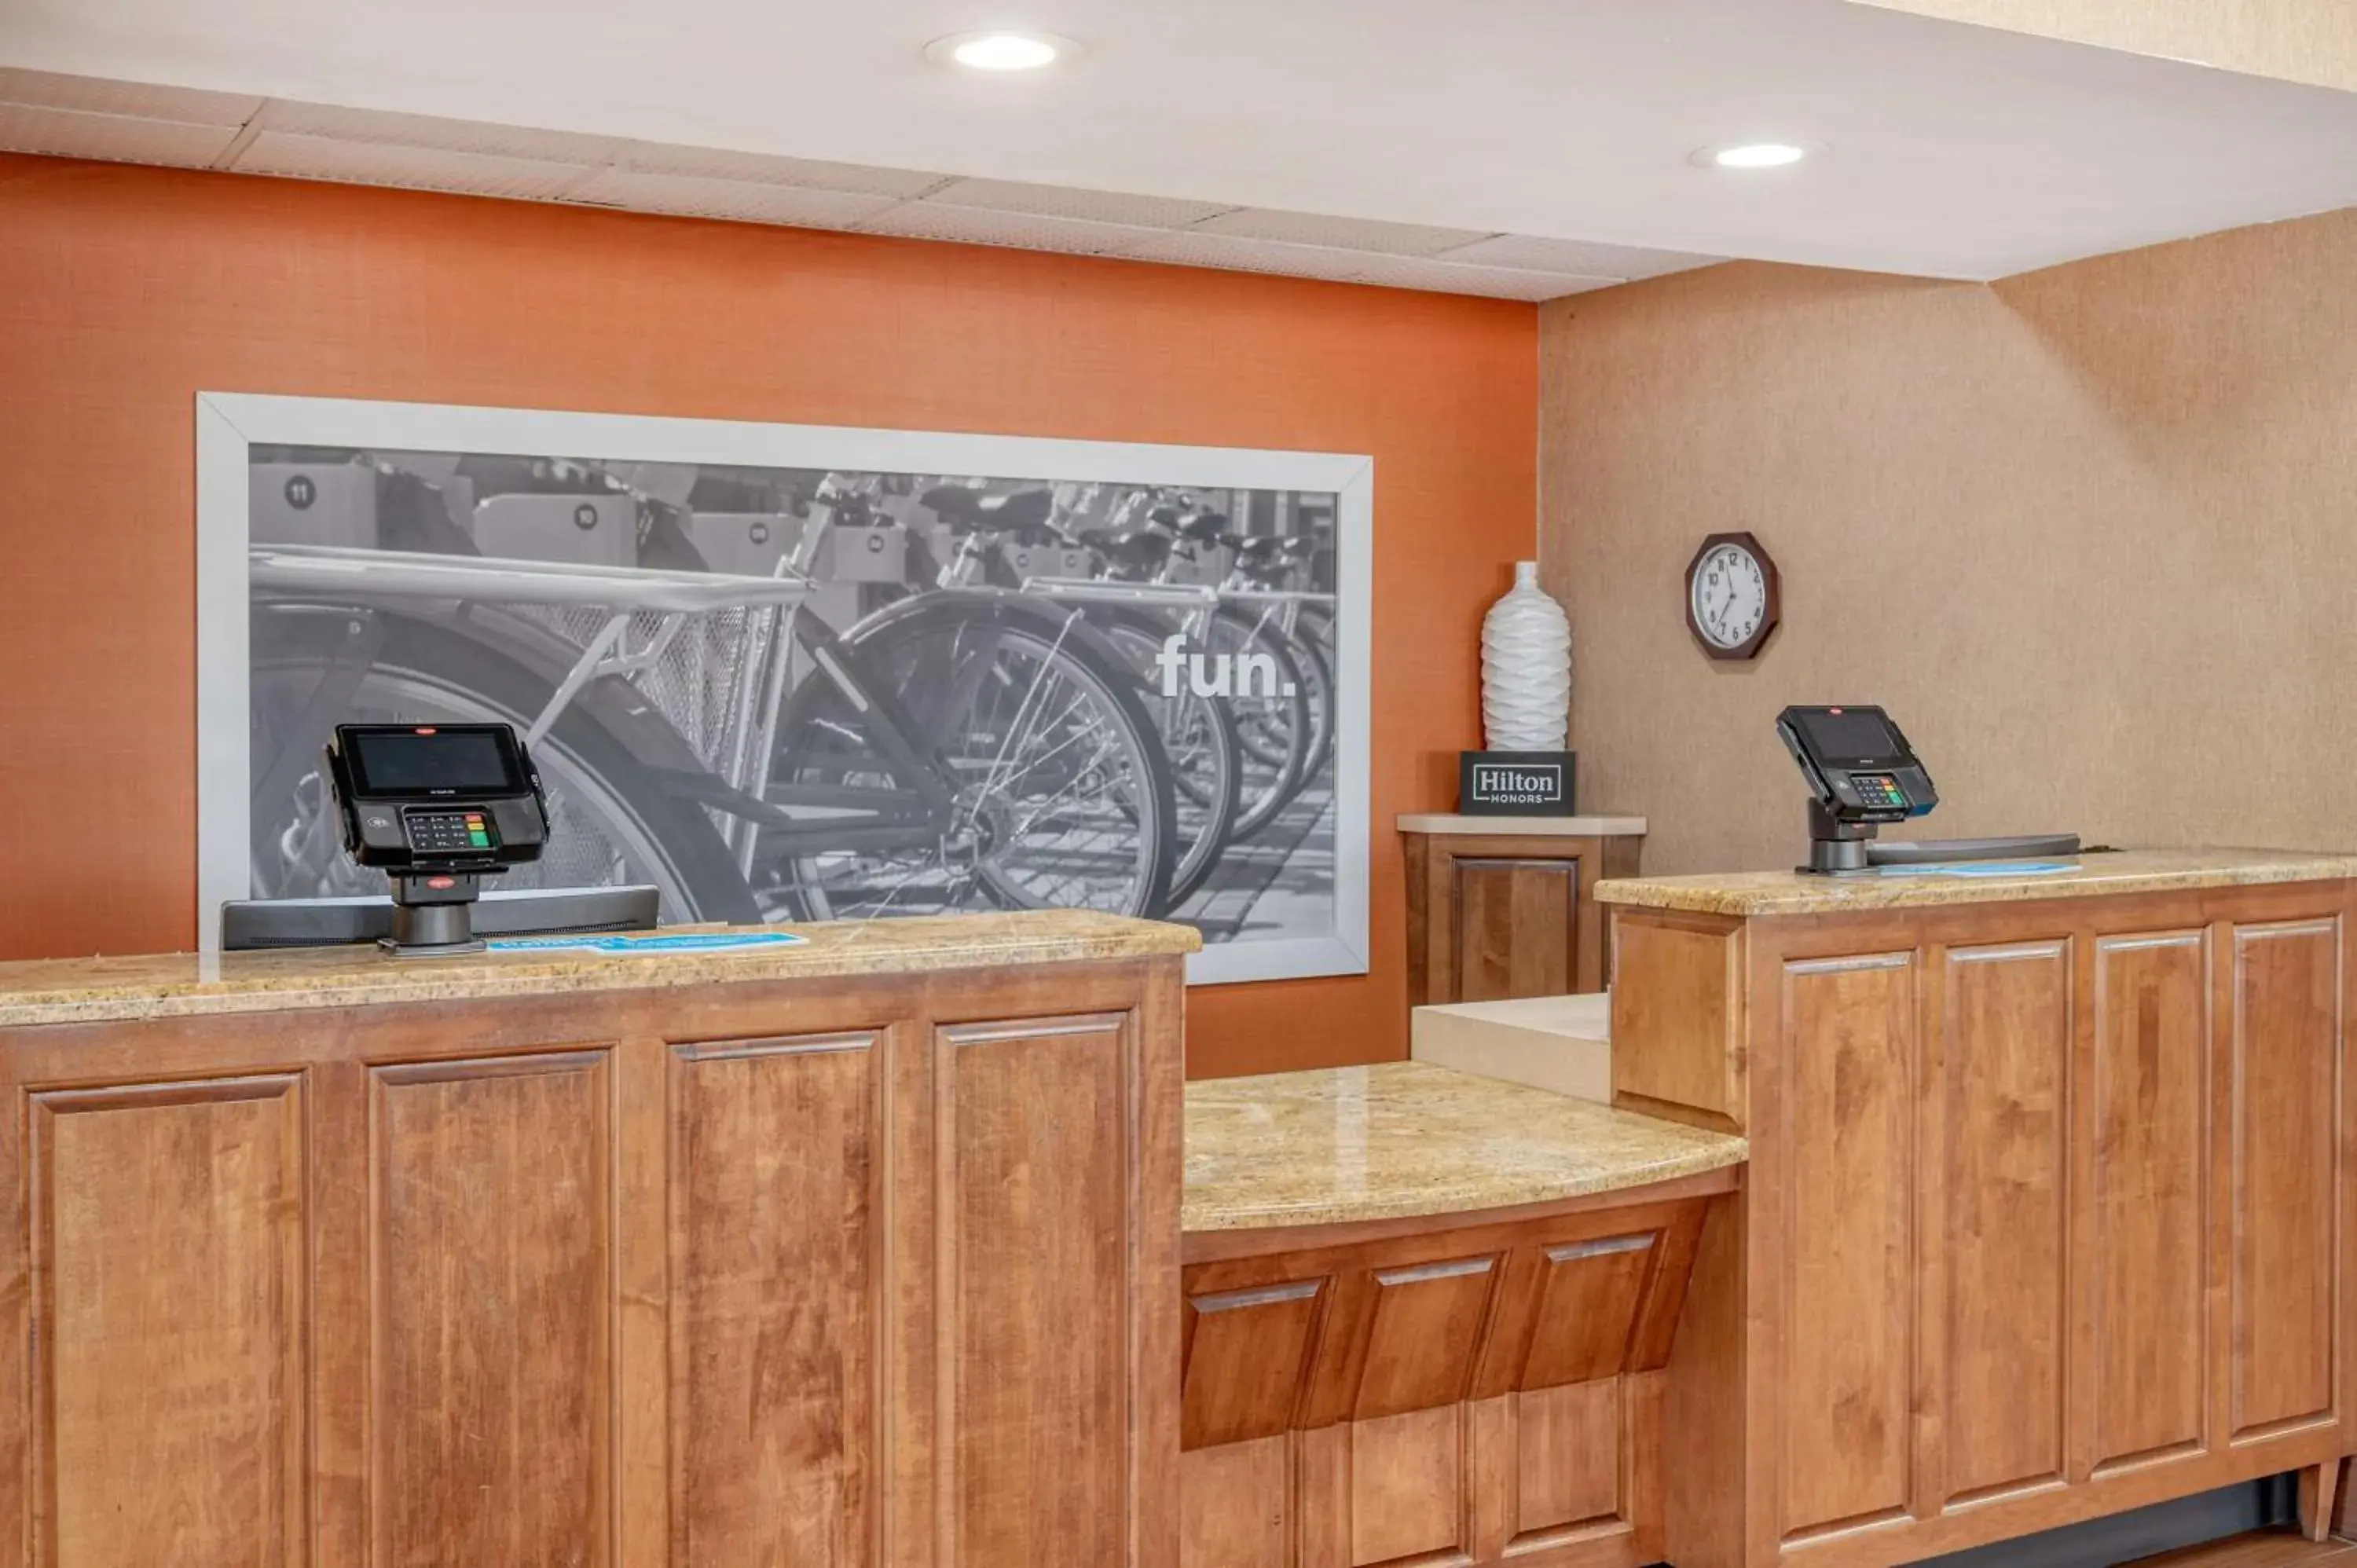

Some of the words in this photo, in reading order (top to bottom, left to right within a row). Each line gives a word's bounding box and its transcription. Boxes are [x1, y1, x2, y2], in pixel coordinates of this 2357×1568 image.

[1717, 559, 1725, 573] 11
[1728, 552, 1738, 566] 12
[1745, 557, 1748, 572] 1
[1708, 573, 1719, 587] 10
[1753, 568, 1760, 584] 2
[1710, 610, 1716, 623] 8
[1720, 622, 1726, 636] 7
[1732, 627, 1739, 641] 6
[1744, 621, 1751, 636] 5
[1156, 633, 1296, 698] fun.
[1480, 771, 1553, 792] Hilton
[1490, 793, 1543, 804] HONORS
